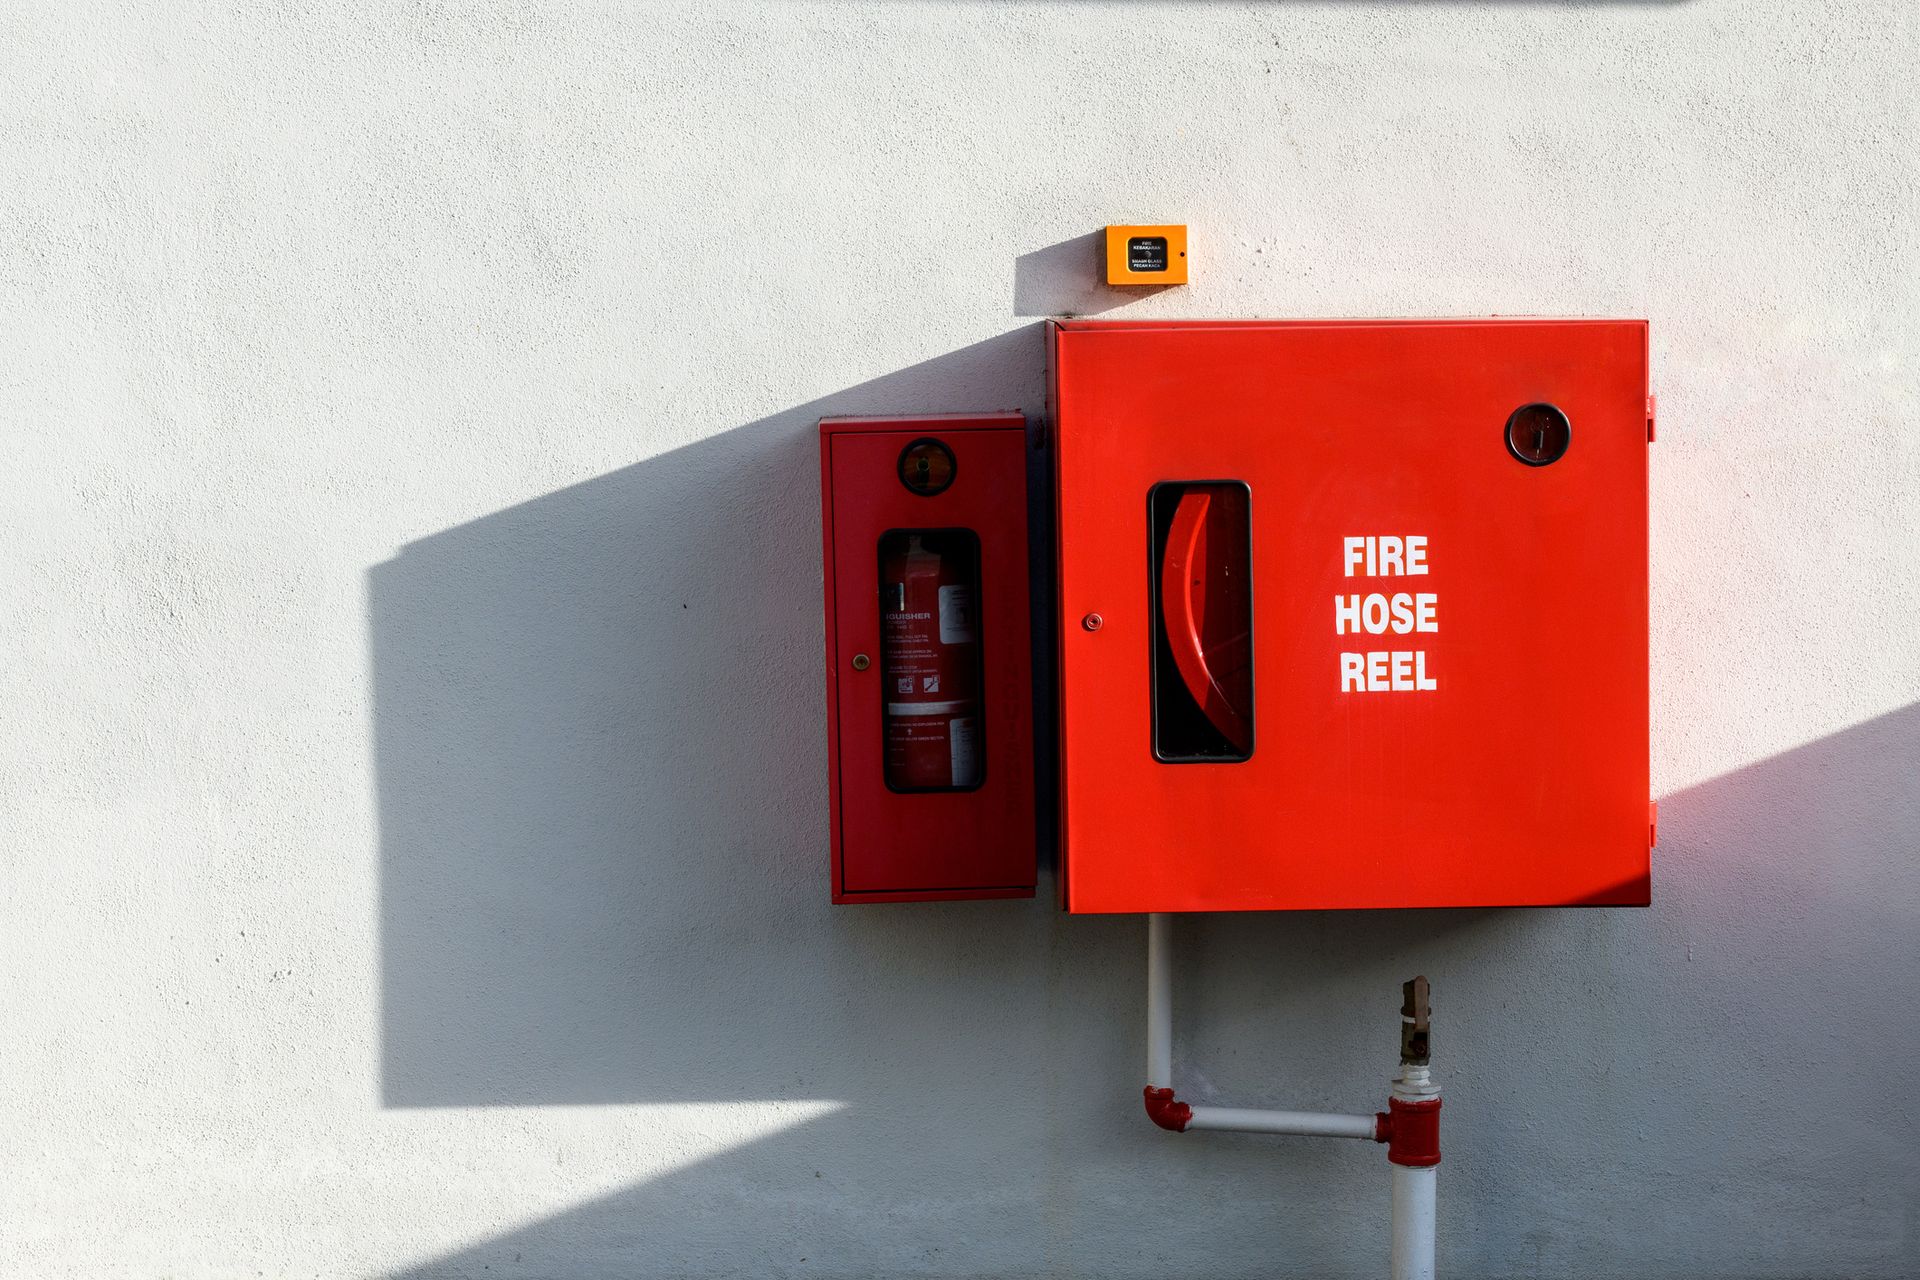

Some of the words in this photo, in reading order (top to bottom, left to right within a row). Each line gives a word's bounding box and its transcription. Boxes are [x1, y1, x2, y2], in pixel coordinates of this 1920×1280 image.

[1344, 535, 1429, 577] FIRE
[1335, 593, 1438, 635] HOSE
[1340, 651, 1437, 692] REEL
